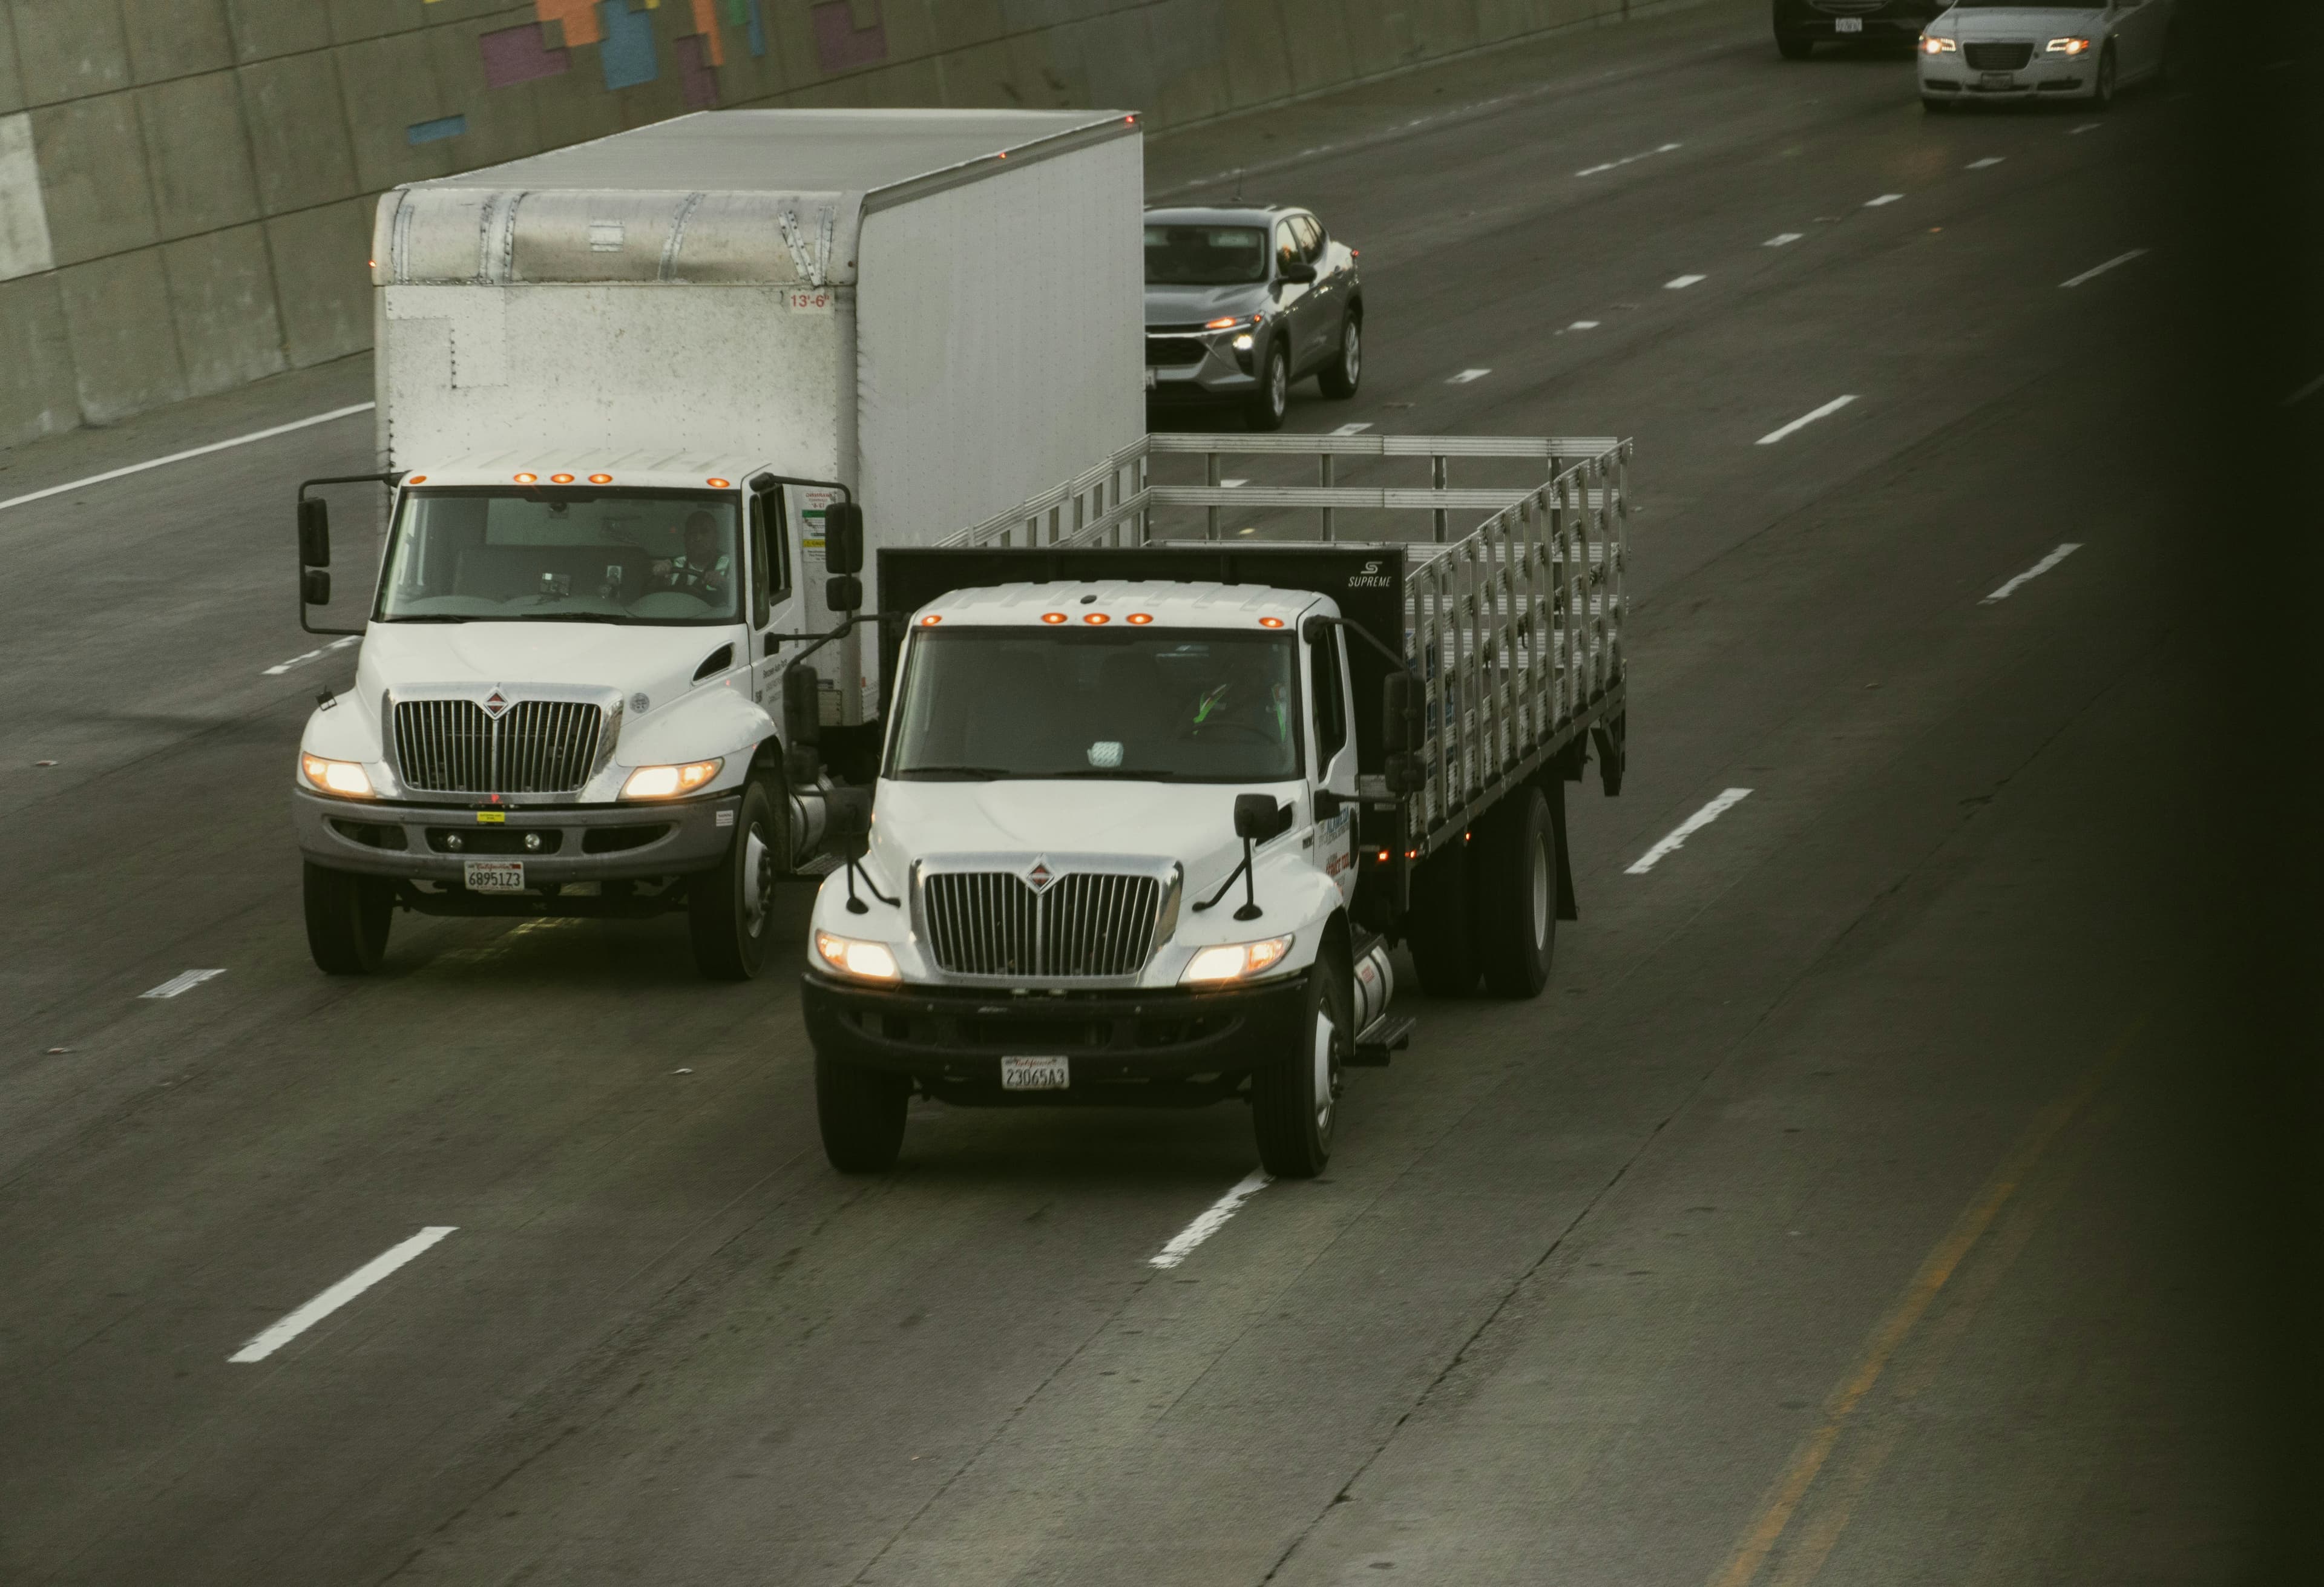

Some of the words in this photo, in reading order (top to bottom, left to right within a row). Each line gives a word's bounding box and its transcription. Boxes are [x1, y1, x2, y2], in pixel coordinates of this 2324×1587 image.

[790, 294, 829, 307] 13'-6"
[1348, 576, 1392, 587] SUPREME
[468, 872, 520, 886] 68951Z3
[1006, 1068, 1065, 1085] 23065A3
